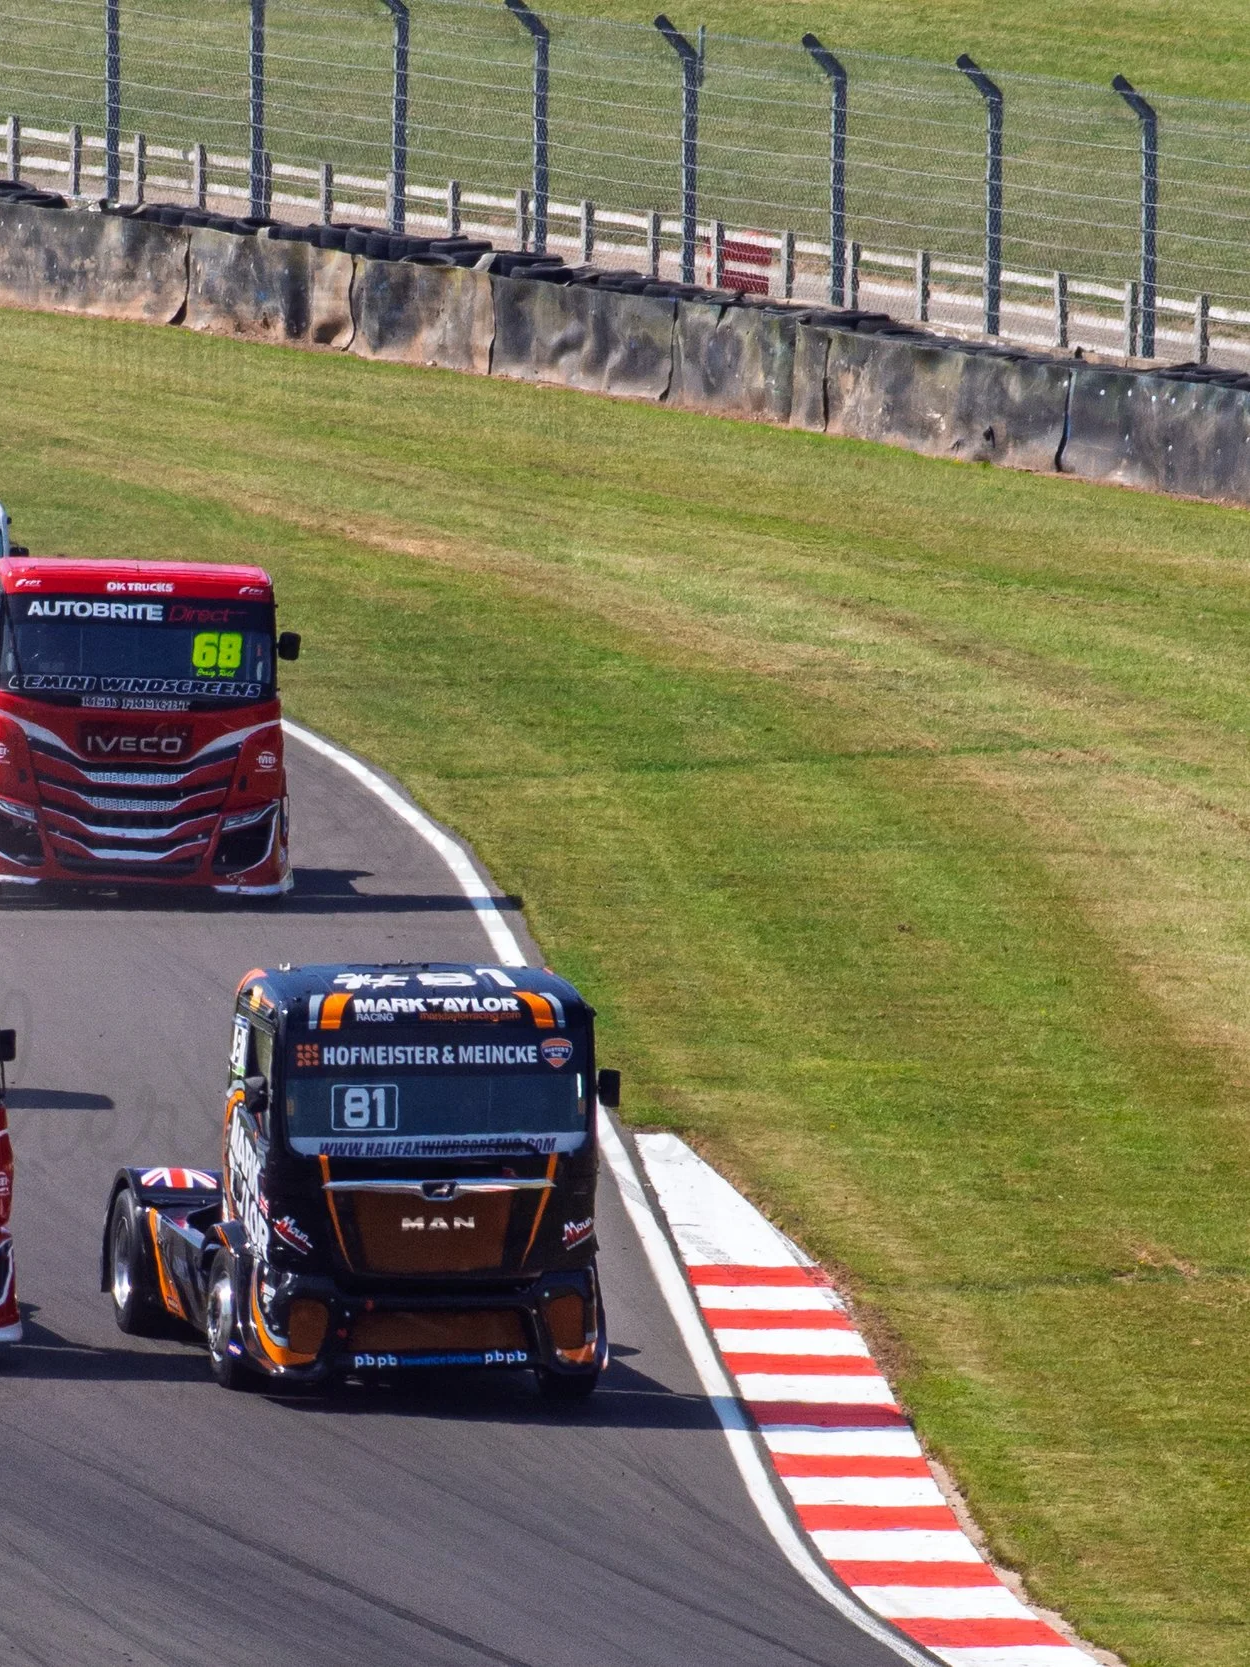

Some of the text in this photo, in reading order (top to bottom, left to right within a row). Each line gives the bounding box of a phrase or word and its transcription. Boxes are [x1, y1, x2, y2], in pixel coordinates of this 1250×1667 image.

[106, 581, 175, 593] OK TRUCKS
[28, 600, 247, 623] AUTOBRITE Direct
[192, 632, 243, 669] 68
[8, 674, 262, 698] GEMINI WINDSCREENS
[86, 733, 183, 754] IVECO
[354, 997, 519, 1013] MARK TAYLOR
[356, 1012, 395, 1022] RACING
[419, 1011, 522, 1023] marktaylorracing.com
[323, 1045, 538, 1066] HOFMEISTER & MEINCKE
[344, 1087, 387, 1128] 81
[401, 1216, 476, 1231] MAN
